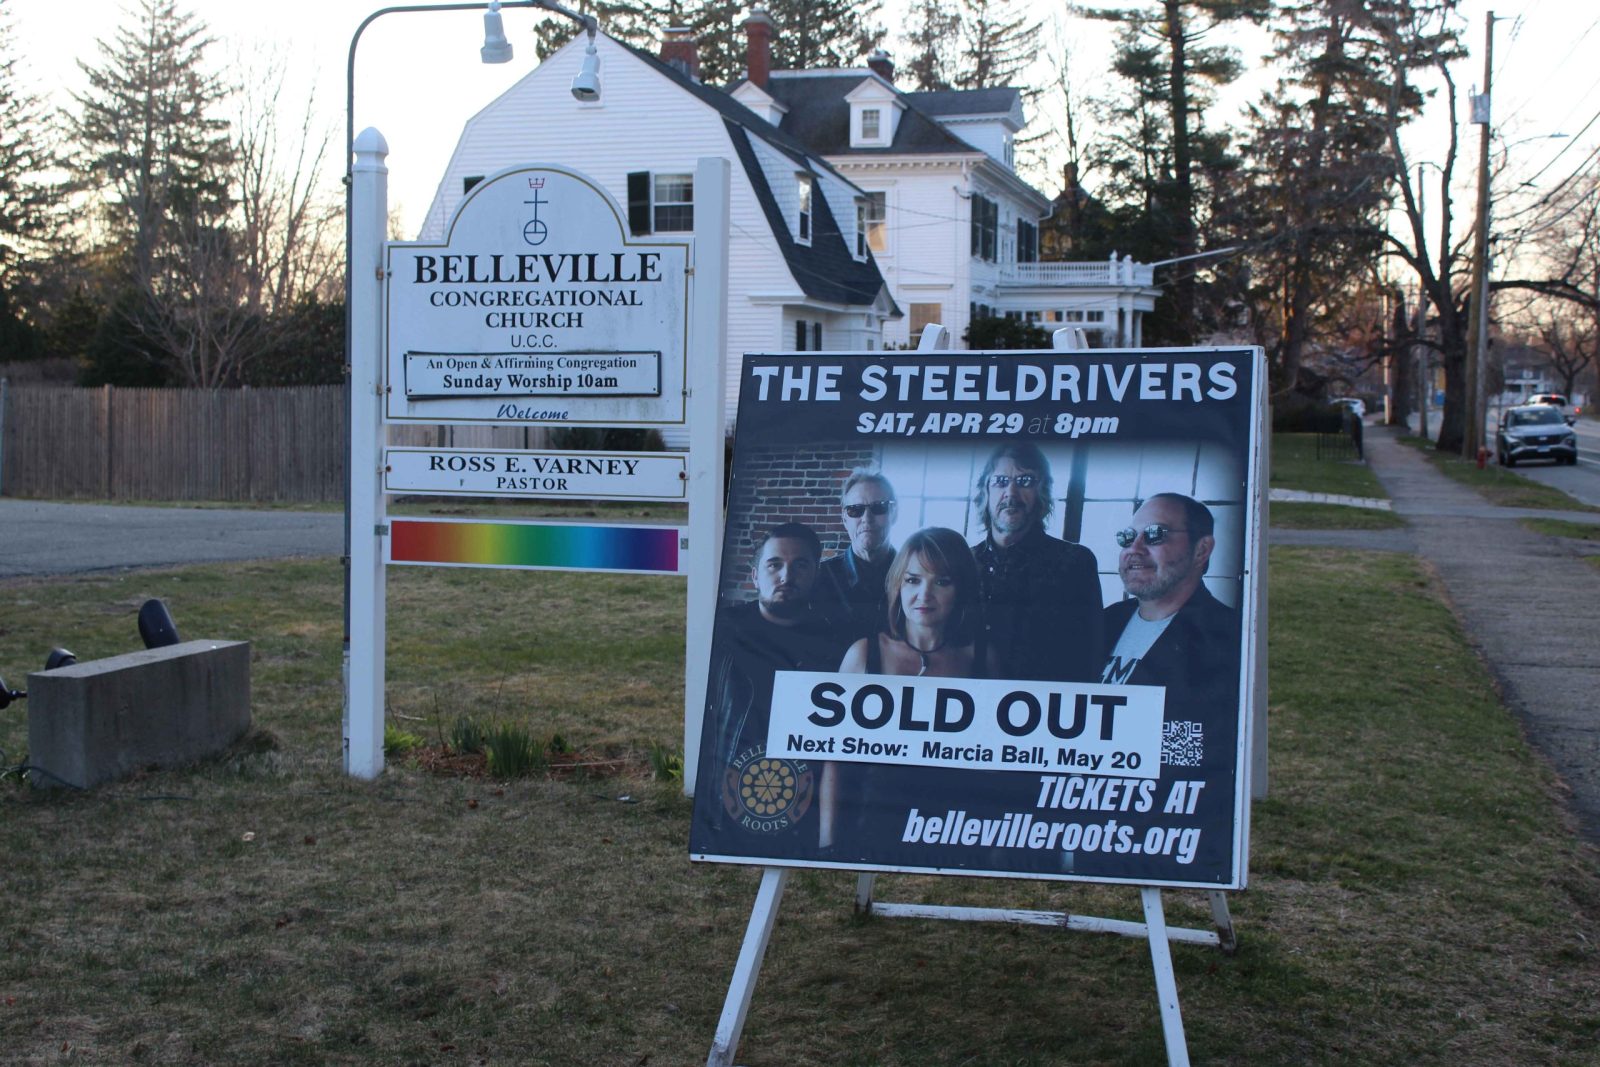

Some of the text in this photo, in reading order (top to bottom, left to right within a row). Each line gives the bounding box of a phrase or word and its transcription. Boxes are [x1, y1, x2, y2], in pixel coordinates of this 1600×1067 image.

[413, 252, 662, 284] BELLEVILLE
[430, 290, 643, 307] CONGREGATIONAL
[485, 312, 584, 328] CHURCH
[511, 334, 558, 348] U.C.C.
[426, 356, 637, 371] An Open & Affirming Congregation
[443, 374, 618, 391] Sunday Worship 10am
[752, 362, 1238, 403] THE STEELDRIVERS
[497, 403, 569, 420] Welcome
[856, 412, 1119, 439] SAT, APR 29 at 8pm
[429, 455, 640, 476] ROSS E. VARNEY
[496, 476, 568, 491] PASTOR
[807, 682, 1128, 741] SOLD OUT
[787, 734, 1142, 771] Next Show: Marcia Ball, May 20
[1036, 775, 1206, 815] TICKETS AT
[741, 816, 789, 832] ROOTS
[902, 808, 1201, 865] bellevilleroots.org
